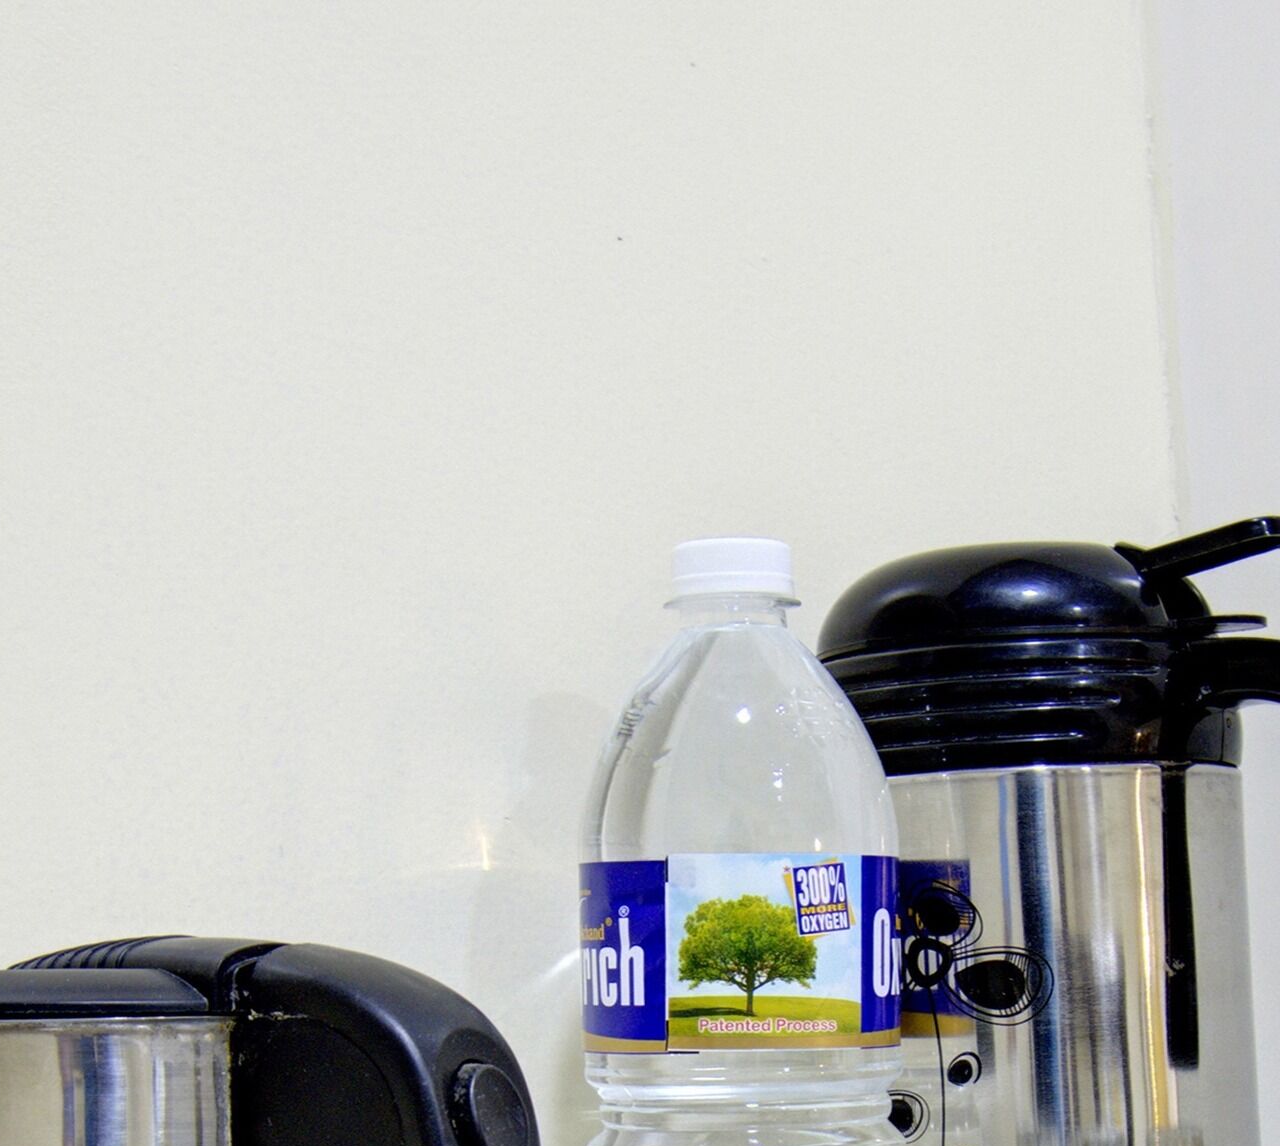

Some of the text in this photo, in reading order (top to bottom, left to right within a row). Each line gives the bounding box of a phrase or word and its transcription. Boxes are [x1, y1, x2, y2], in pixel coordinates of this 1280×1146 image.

[797, 864, 845, 907] 300%
[801, 903, 846, 915] MORE
[801, 912, 848, 932] OXYGEN
[698, 1018, 837, 1033] Patented Process
